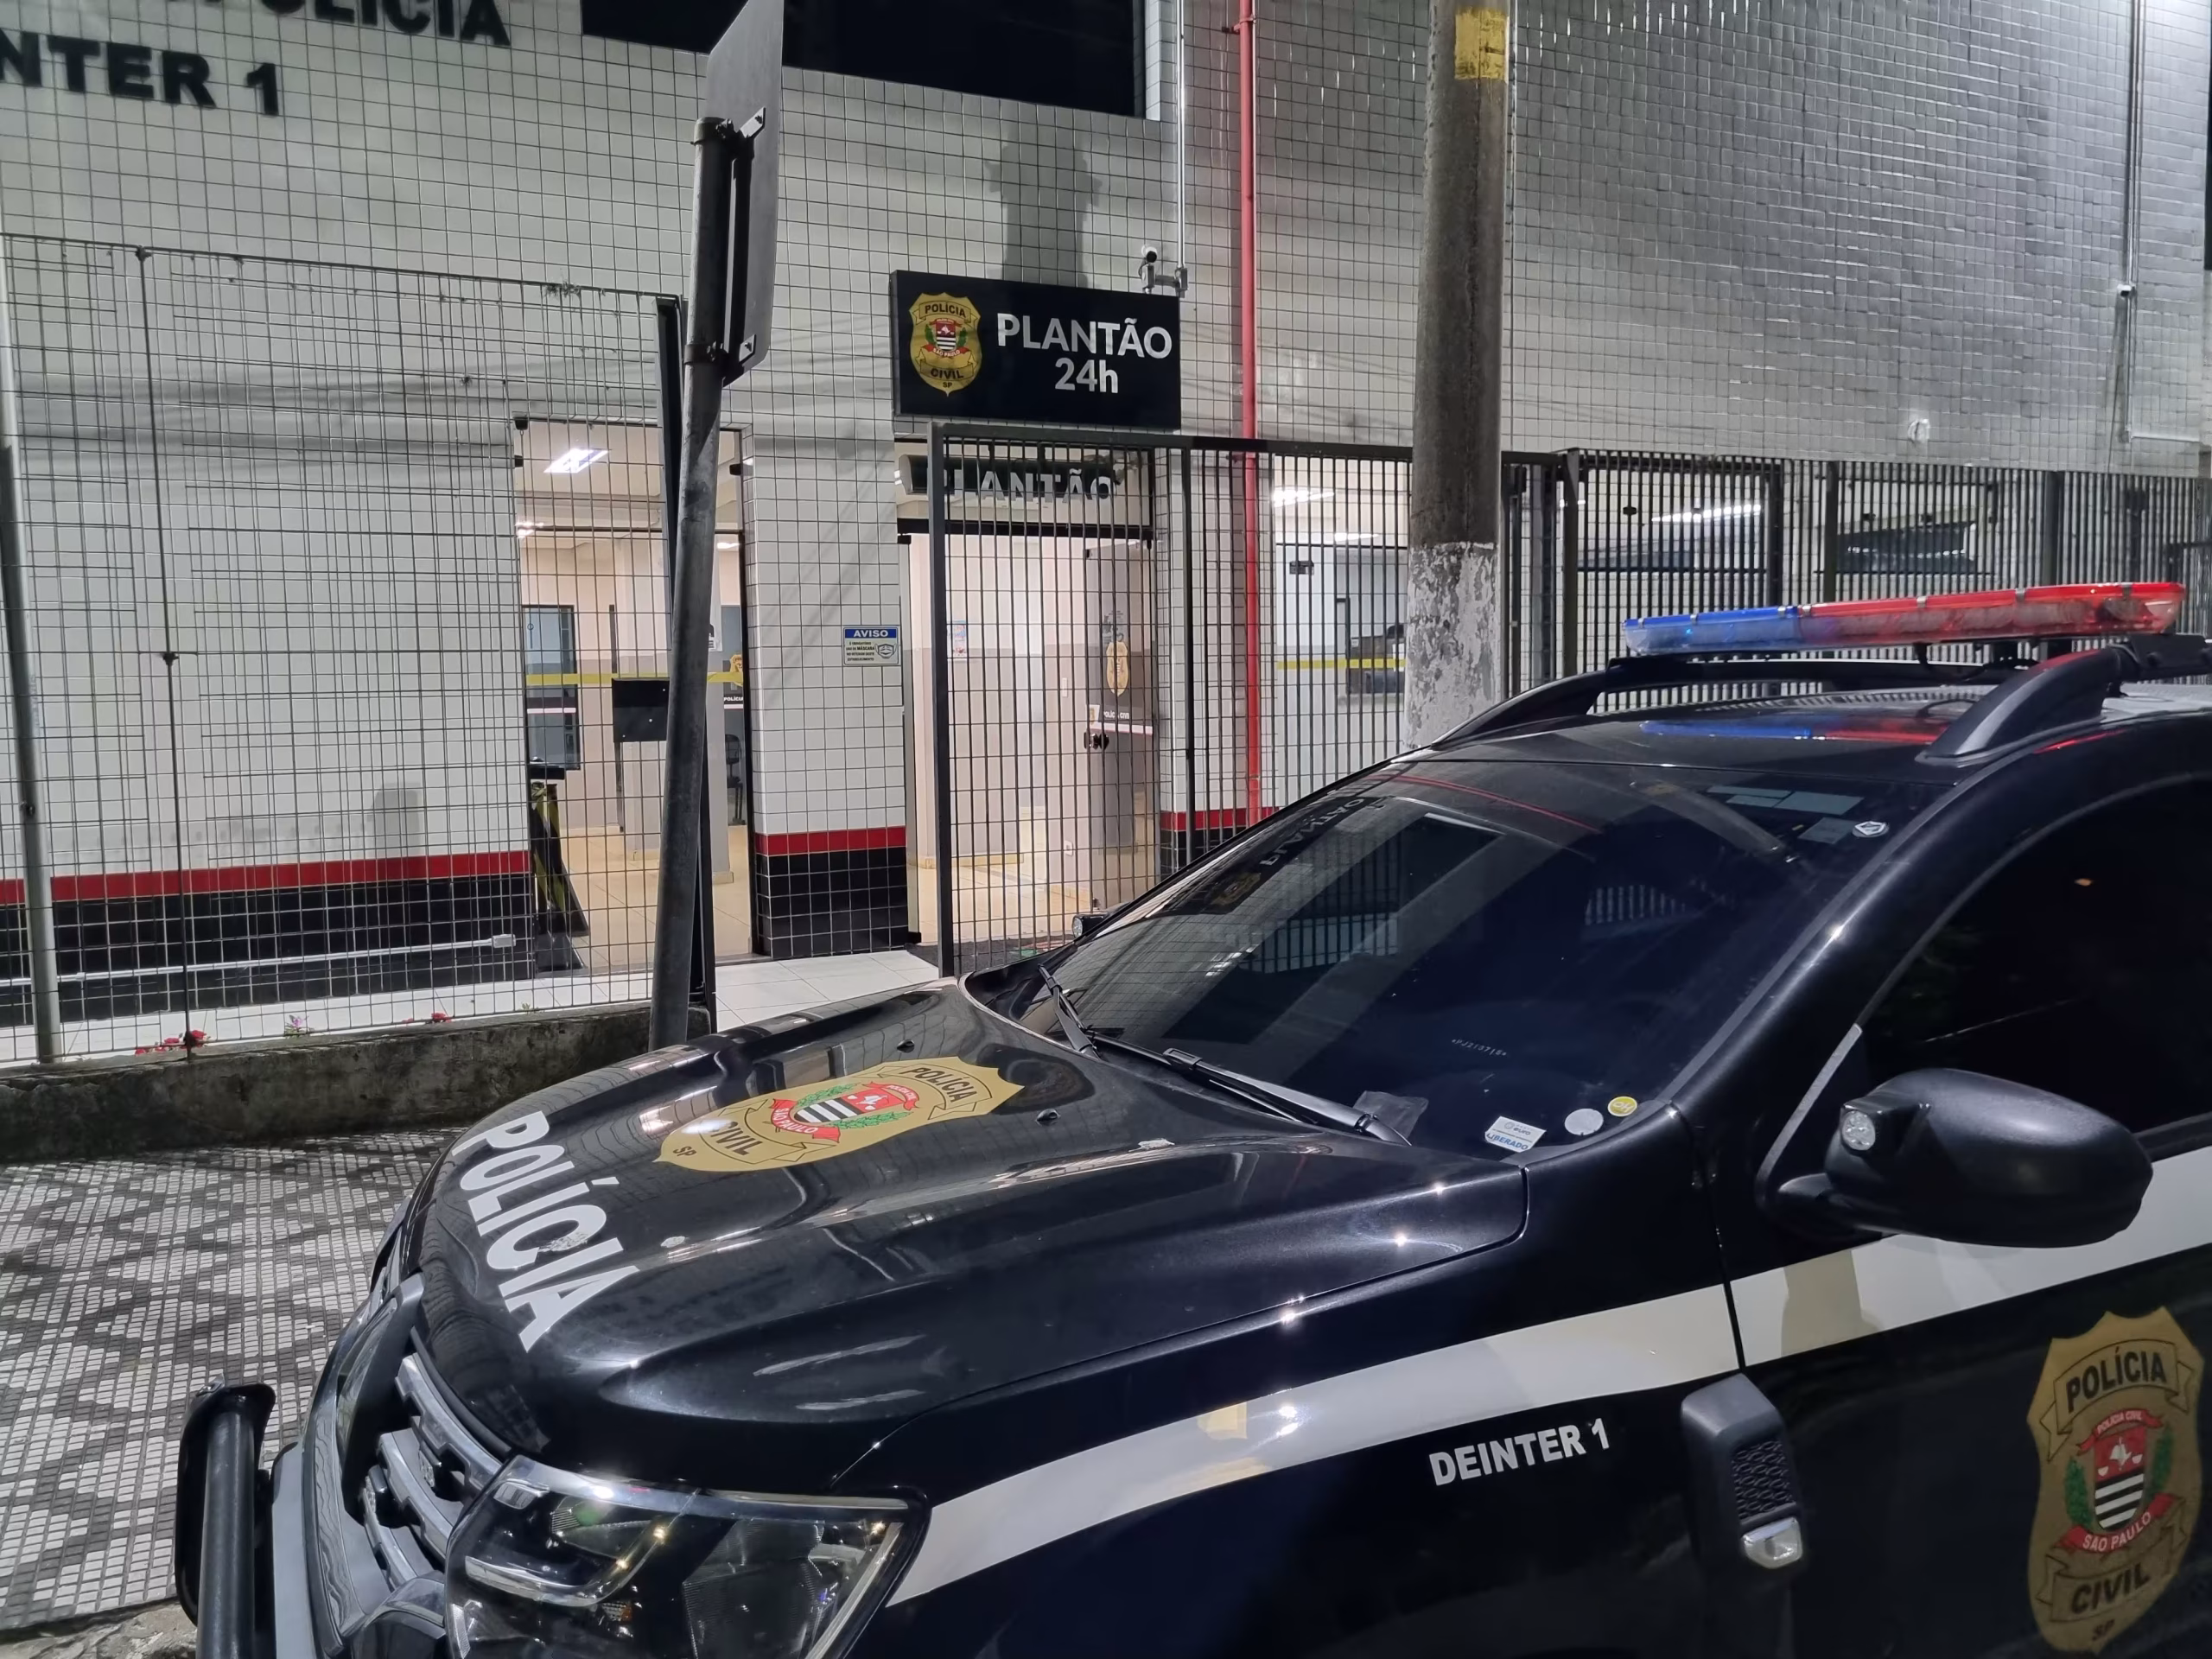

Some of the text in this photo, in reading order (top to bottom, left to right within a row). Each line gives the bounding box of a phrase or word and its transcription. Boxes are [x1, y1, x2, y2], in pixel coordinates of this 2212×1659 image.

[245, 62, 279, 116] 1
[997, 313, 1172, 359] PLANTÃO
[931, 368, 963, 378] CIVIL
[1055, 357, 1118, 393] 24h
[944, 468, 1117, 503] LANTÃO
[899, 1067, 977, 1103] POLÍCIA
[778, 1120, 819, 1133] PAULO
[1486, 1133, 1529, 1150] LIBERADO
[673, 1146, 697, 1157] SP
[451, 1110, 640, 1353] POLÍCIA
[2066, 1345, 2167, 1414] POLÍCIA
[1429, 1418, 1610, 1486] DEINTER 1
[2111, 1511, 2152, 1549] PAULO
[2071, 1562, 2152, 1614] CIVIL
[2092, 1619, 2115, 1641] SP
